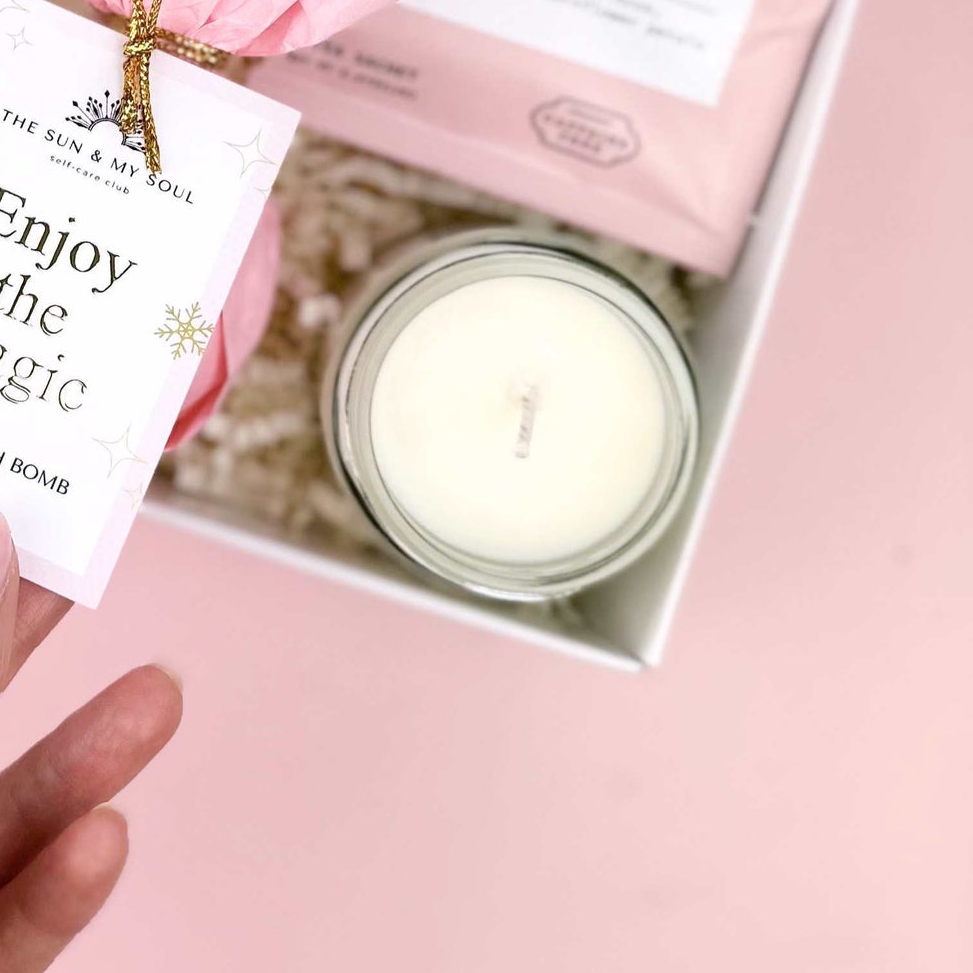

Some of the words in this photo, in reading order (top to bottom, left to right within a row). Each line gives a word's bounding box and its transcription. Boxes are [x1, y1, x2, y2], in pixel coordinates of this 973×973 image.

[2, 108, 38, 135] THE
[44, 127, 84, 155] SUN
[90, 148, 104, 164] &
[110, 157, 141, 178] MY
[145, 173, 195, 205] SOUL
[49, 153, 102, 182] self-care
[105, 178, 131, 196] club
[10, 457, 72, 496] BOMB
